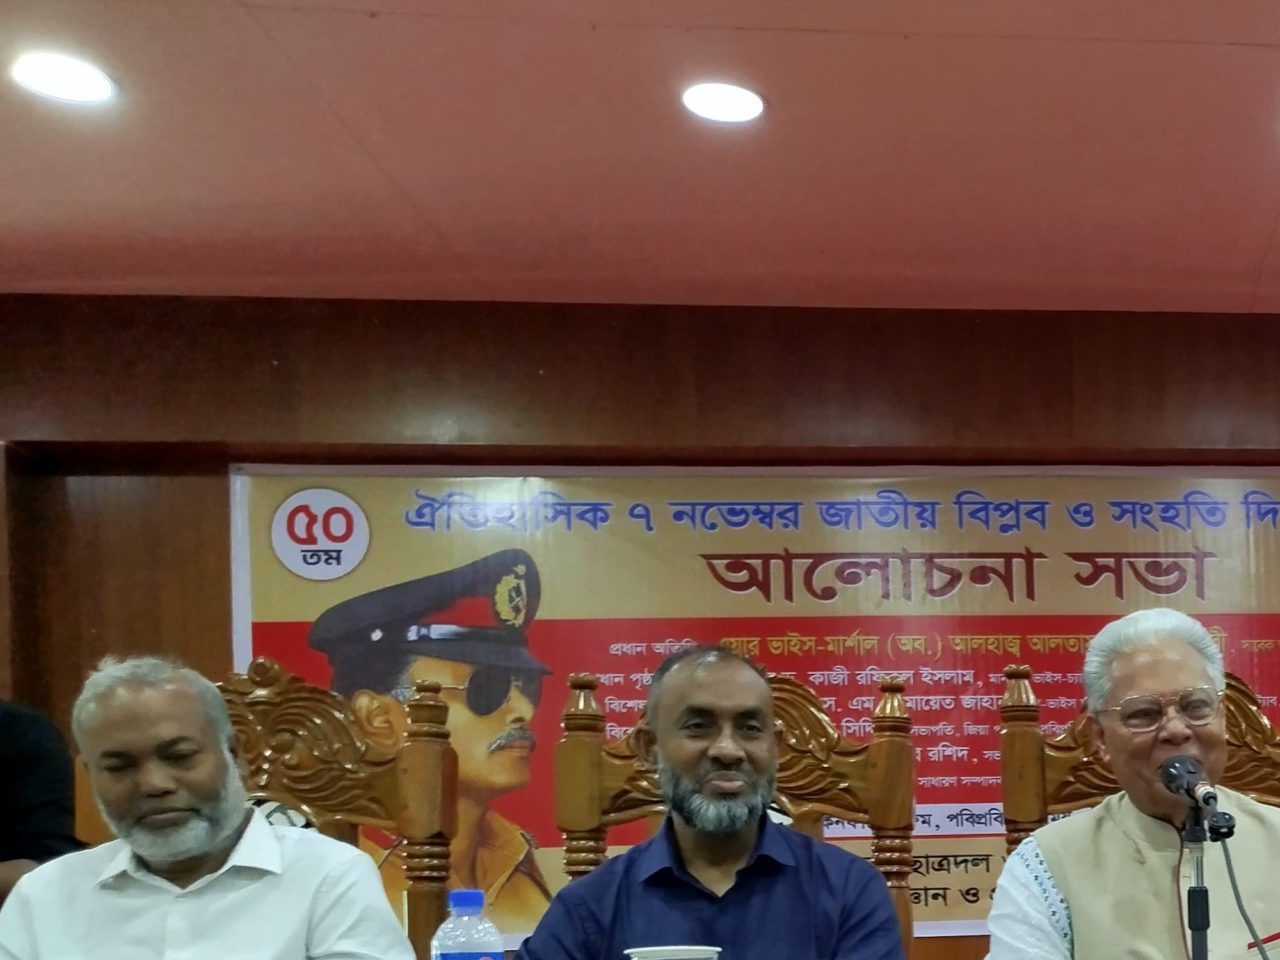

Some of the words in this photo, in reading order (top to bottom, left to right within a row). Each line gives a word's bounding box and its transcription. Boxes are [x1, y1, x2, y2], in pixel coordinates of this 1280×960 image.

[286, 504, 354, 545] ৫০
[404, 489, 613, 532] ঐতিহাসিক
[628, 502, 655, 532] ৭
[668, 501, 803, 531] নভেম্বর
[816, 489, 941, 531] জাতীয়
[953, 490, 1051, 534] বিপ্লব
[1065, 502, 1095, 528] ও
[1107, 490, 1229, 532] সংহতি
[301, 549, 342, 566] তম
[697, 545, 1049, 603] আলোচনা
[1063, 545, 1218, 602] সভা
[609, 642, 647, 656] প্রধান
[766, 629, 880, 657] ভাইস-মার্শাল
[887, 633, 943, 660] (অব.)
[807, 665, 851, 686] কাজী
[903, 695, 955, 712] মায়েত
[958, 887, 980, 904] ও
